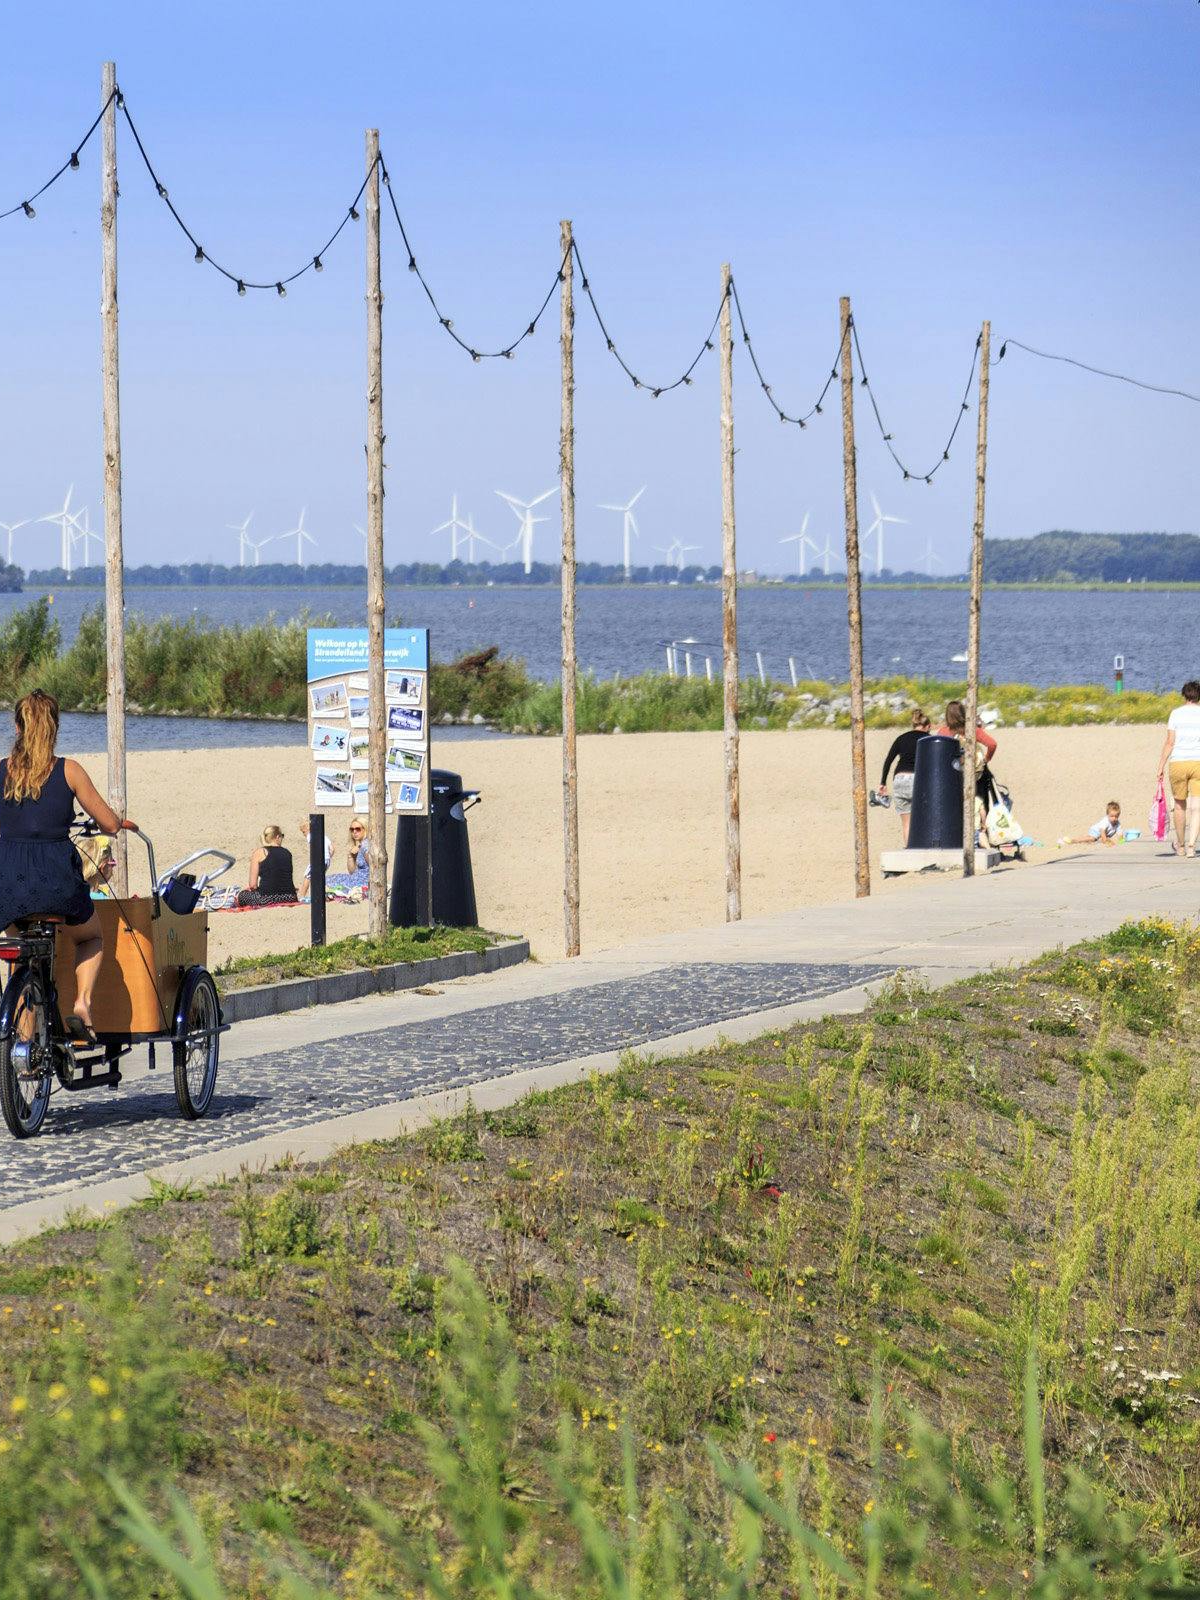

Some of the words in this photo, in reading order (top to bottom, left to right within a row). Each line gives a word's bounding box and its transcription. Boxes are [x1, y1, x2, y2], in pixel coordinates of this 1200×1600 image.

[314, 639, 346, 648] Welkom
[347, 641, 358, 650] op
[358, 639, 369, 648] he
